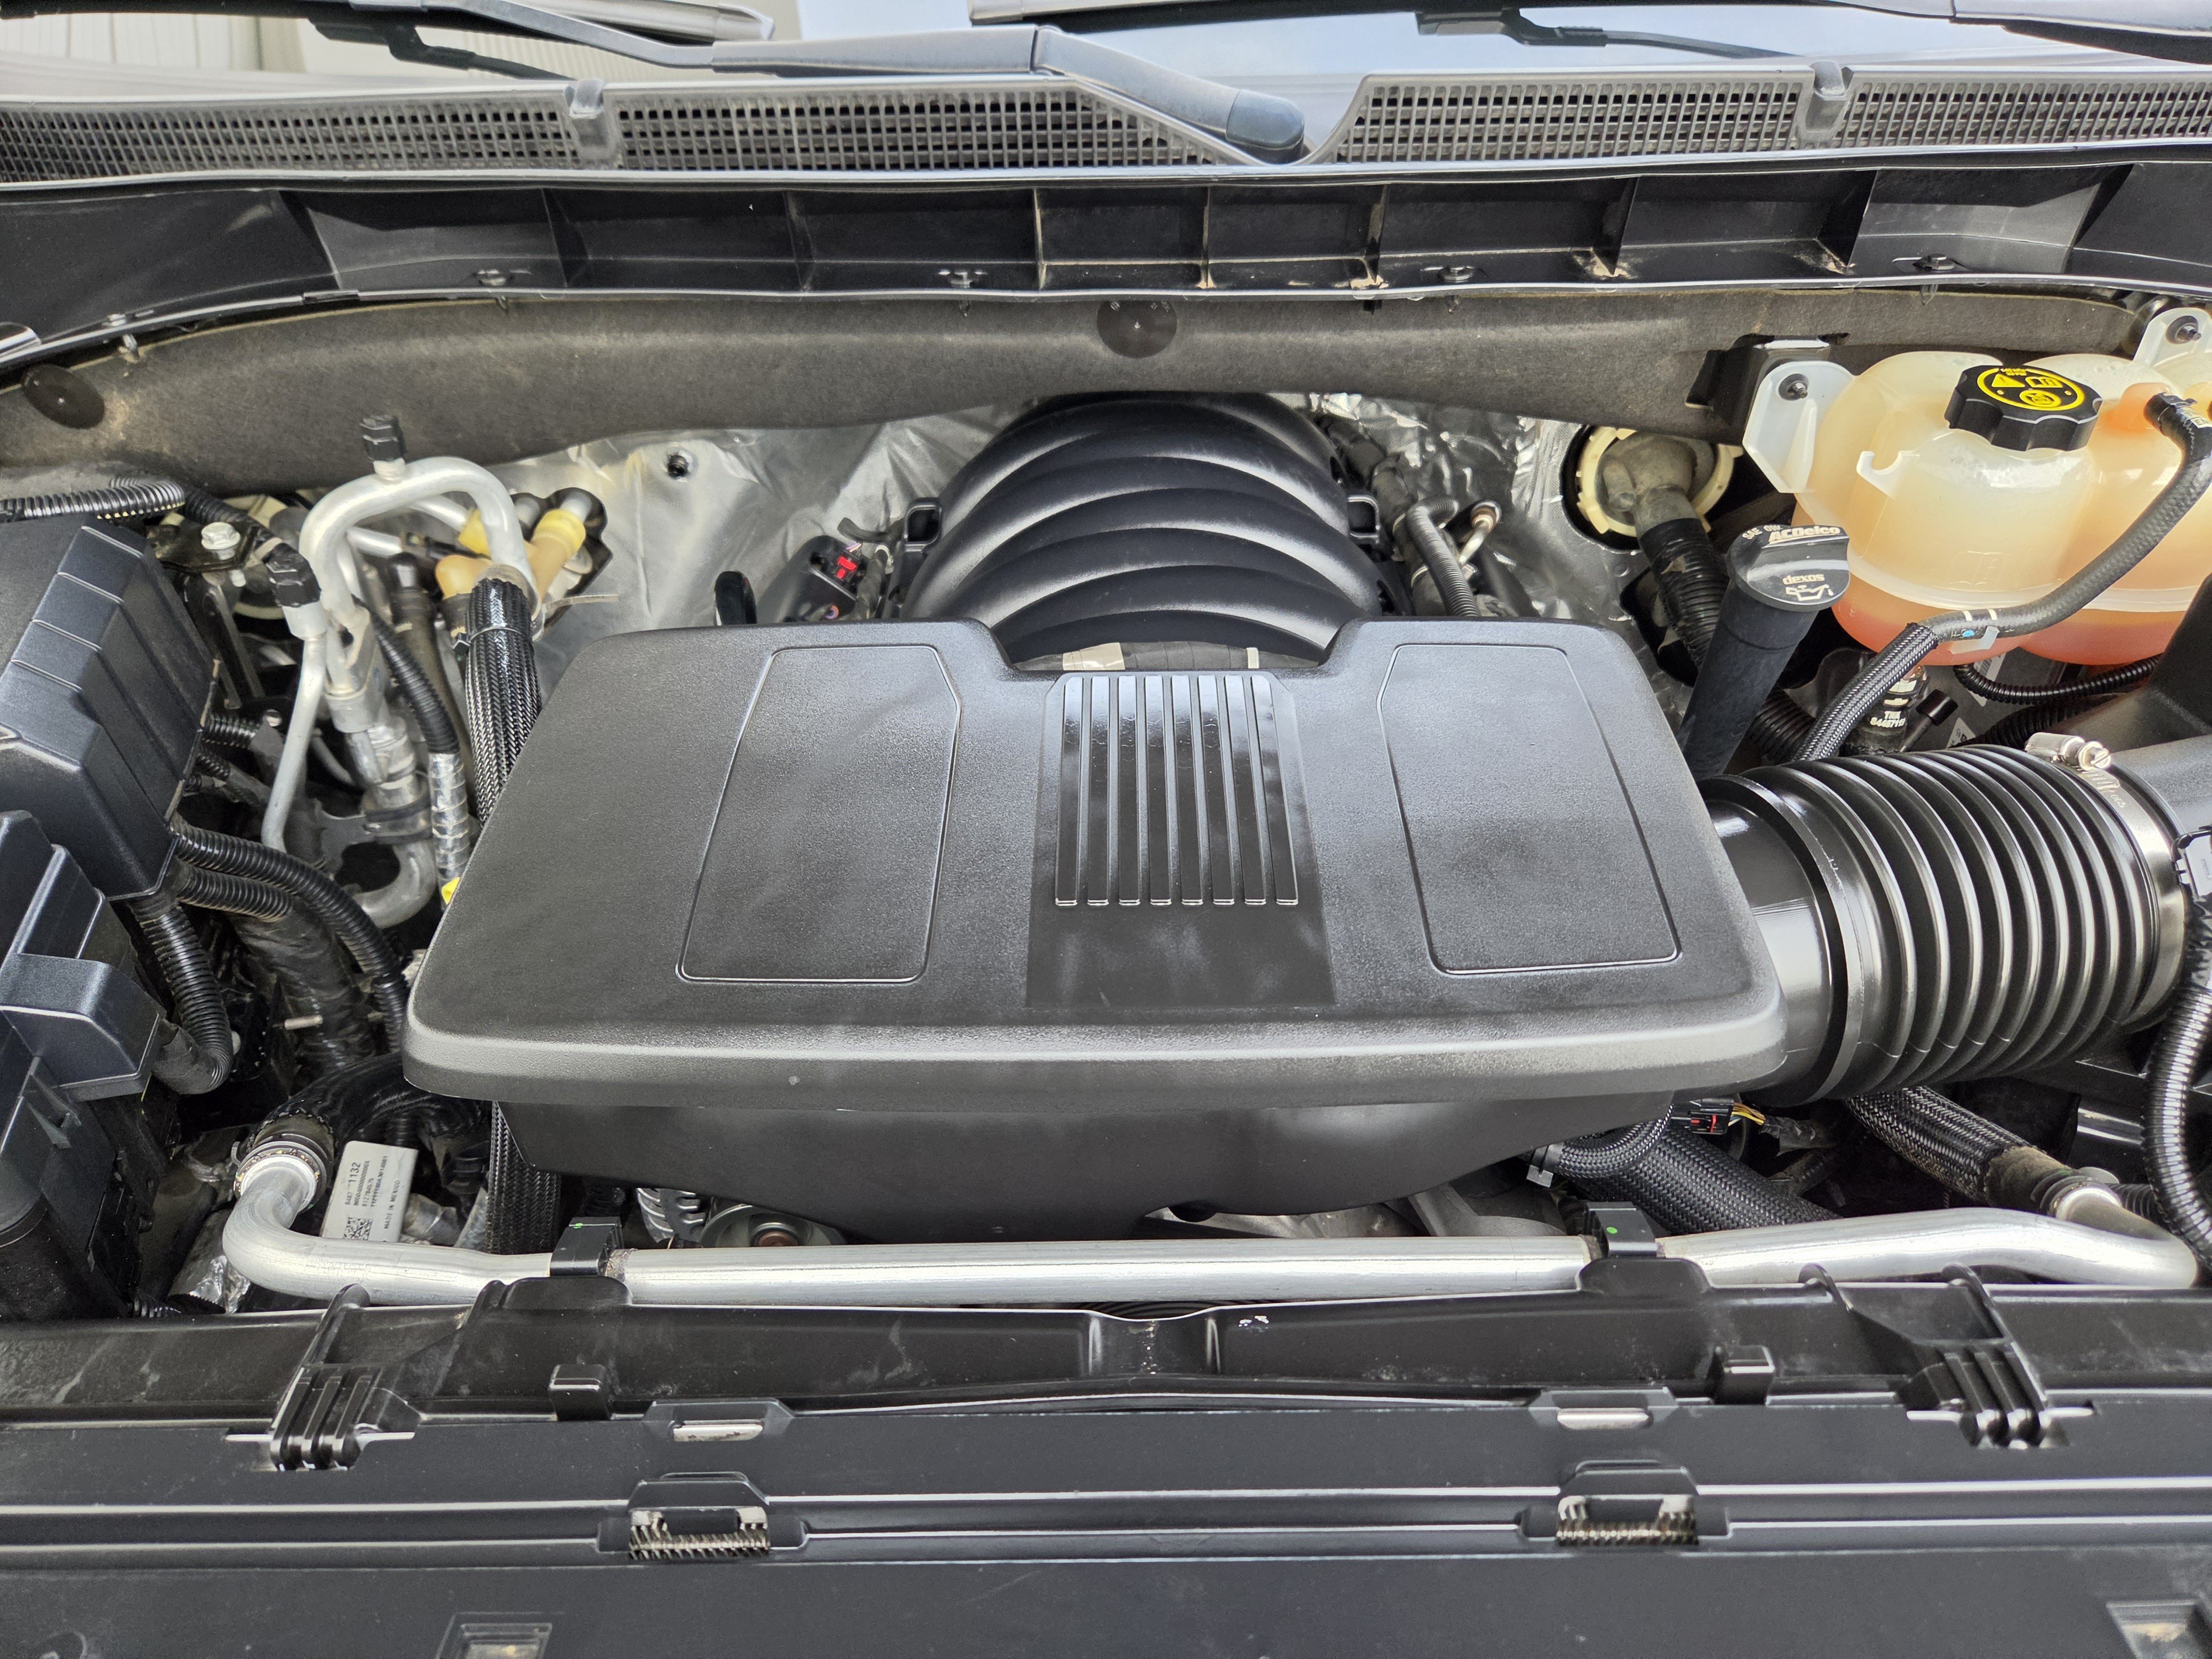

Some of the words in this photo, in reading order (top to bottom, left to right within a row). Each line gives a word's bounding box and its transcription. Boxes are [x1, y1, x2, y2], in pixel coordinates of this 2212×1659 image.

[1742, 528, 1763, 540] SAE
[1768, 525, 1840, 543] ACDelco
[1782, 573, 1825, 585] dexos
[348, 1162, 361, 1182] 1132
[384, 1213, 393, 1229] MADE
[390, 1180, 400, 1202] MEXICO
